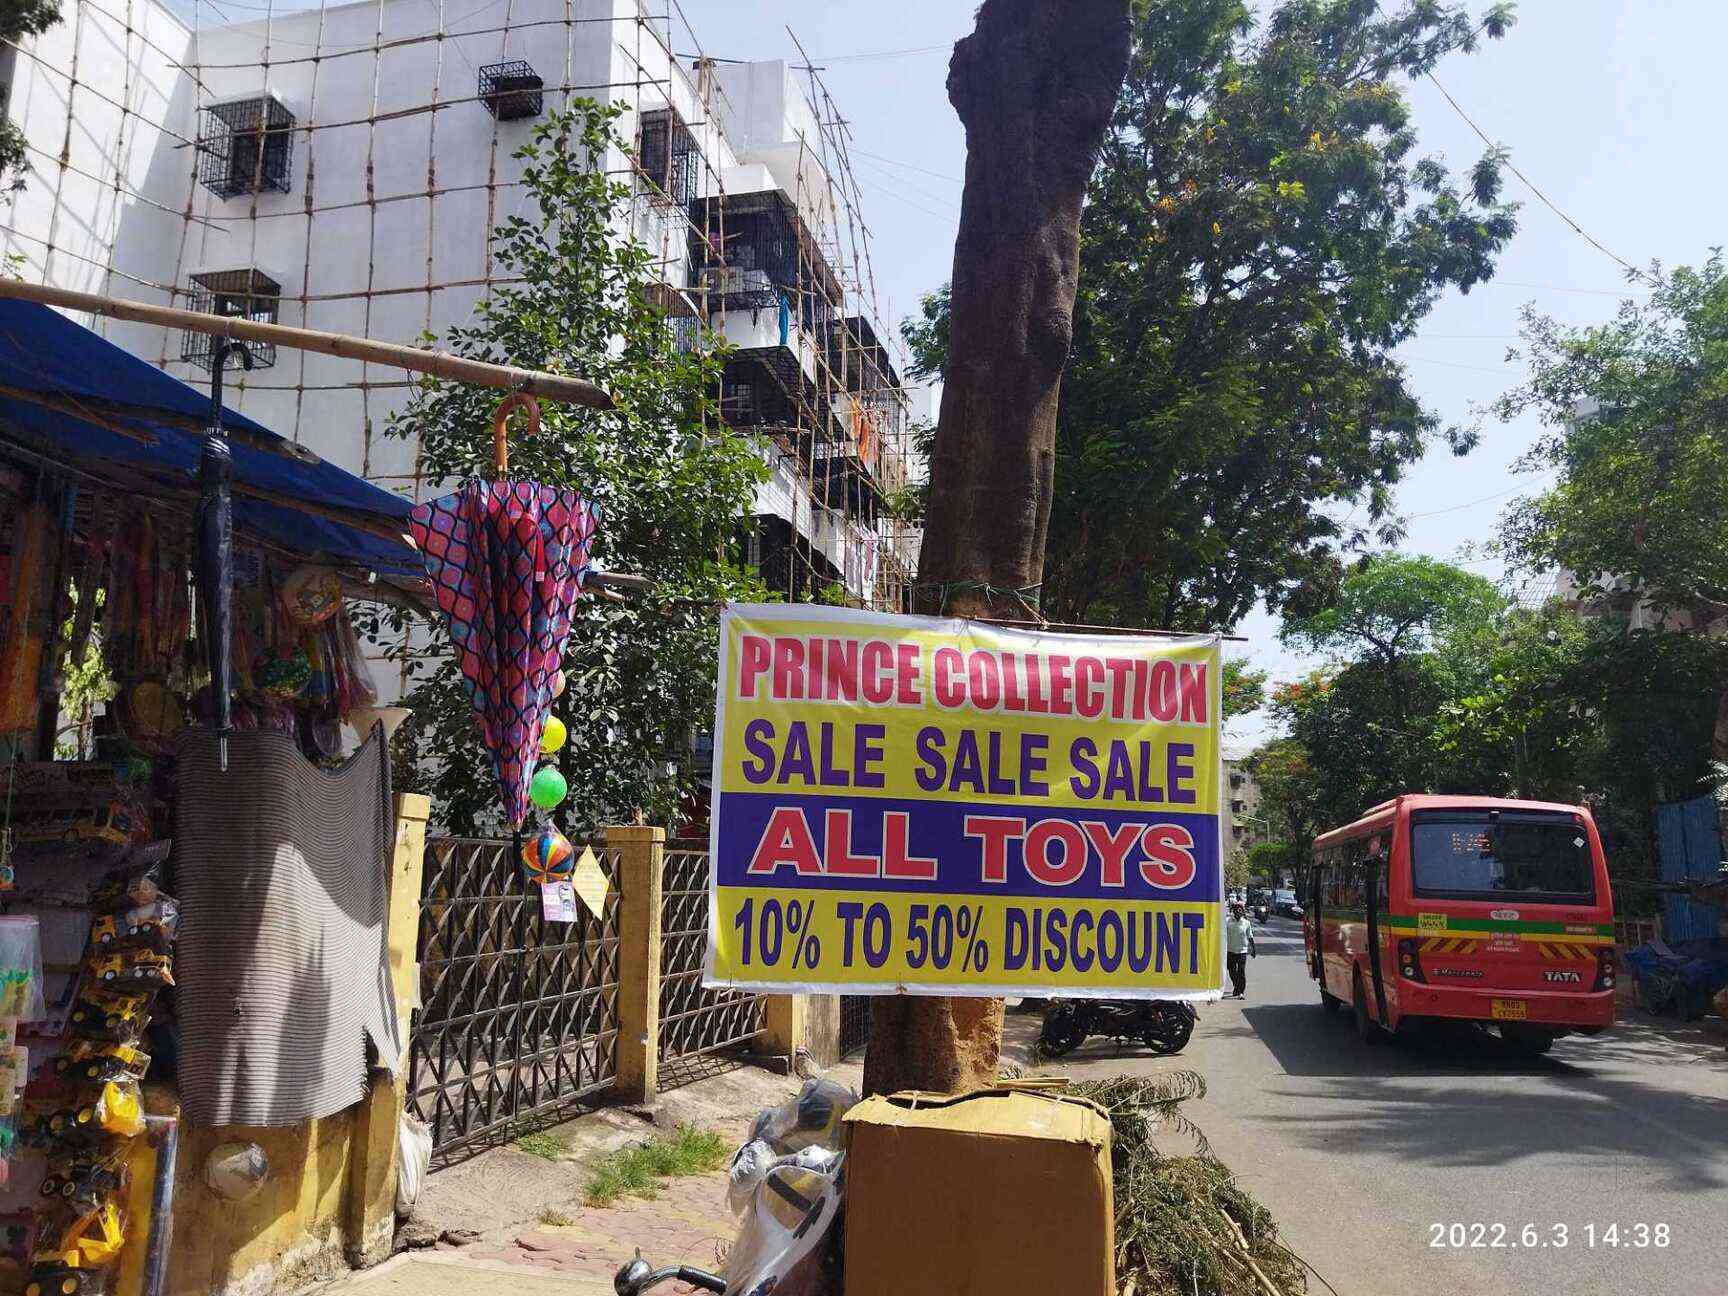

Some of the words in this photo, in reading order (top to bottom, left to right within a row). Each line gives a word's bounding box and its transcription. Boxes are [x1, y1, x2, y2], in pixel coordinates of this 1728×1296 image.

[739, 634, 923, 706] PRINCE
[934, 646, 1208, 725] COLLECTION
[742, 719, 885, 788] SALE
[915, 727, 1049, 797] SALE
[1069, 737, 1196, 804] SALE
[750, 808, 936, 879] ALL
[965, 816, 1195, 888] TOYS
[735, 898, 819, 968] 10%
[837, 902, 891, 966] TO
[908, 905, 989, 970] 50%
[1005, 908, 1204, 973] DISCOUNT
[1545, 971, 1581, 983] TATA
